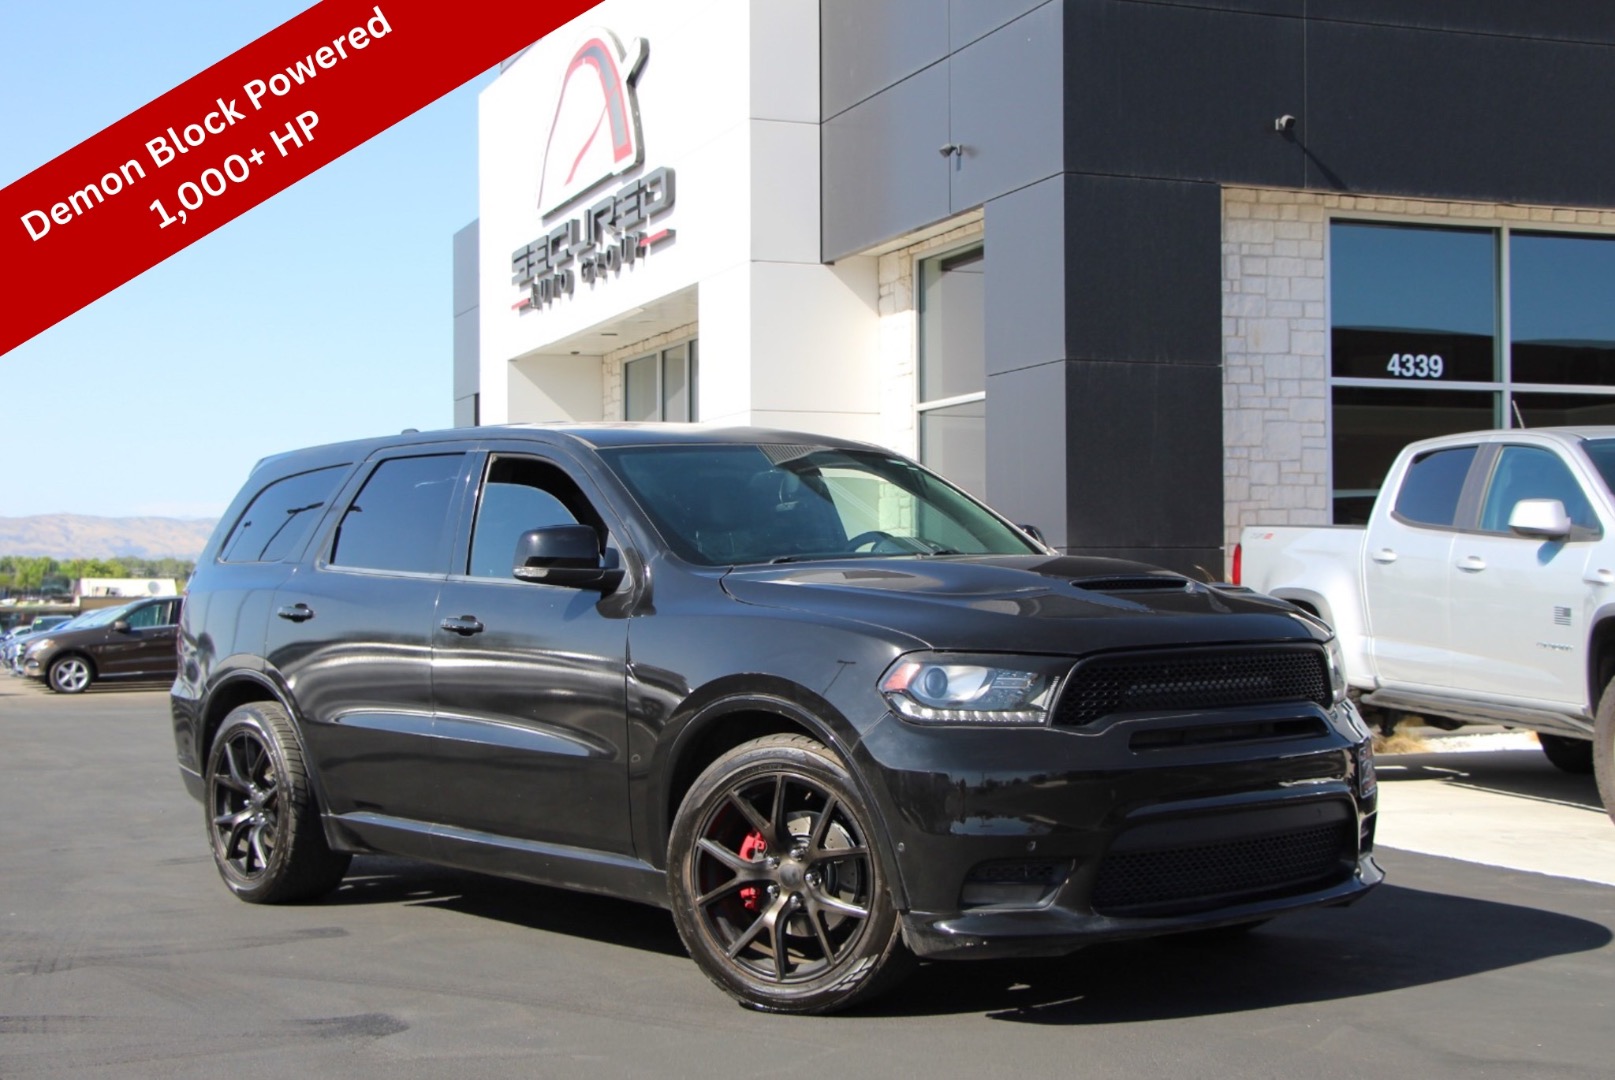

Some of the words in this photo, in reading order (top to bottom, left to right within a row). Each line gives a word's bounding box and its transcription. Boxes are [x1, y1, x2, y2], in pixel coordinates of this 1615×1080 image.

[511, 166, 676, 288] SECURED
[531, 268, 575, 309] AUTO
[581, 231, 648, 285] GROUP
[1387, 353, 1444, 378] 4339
